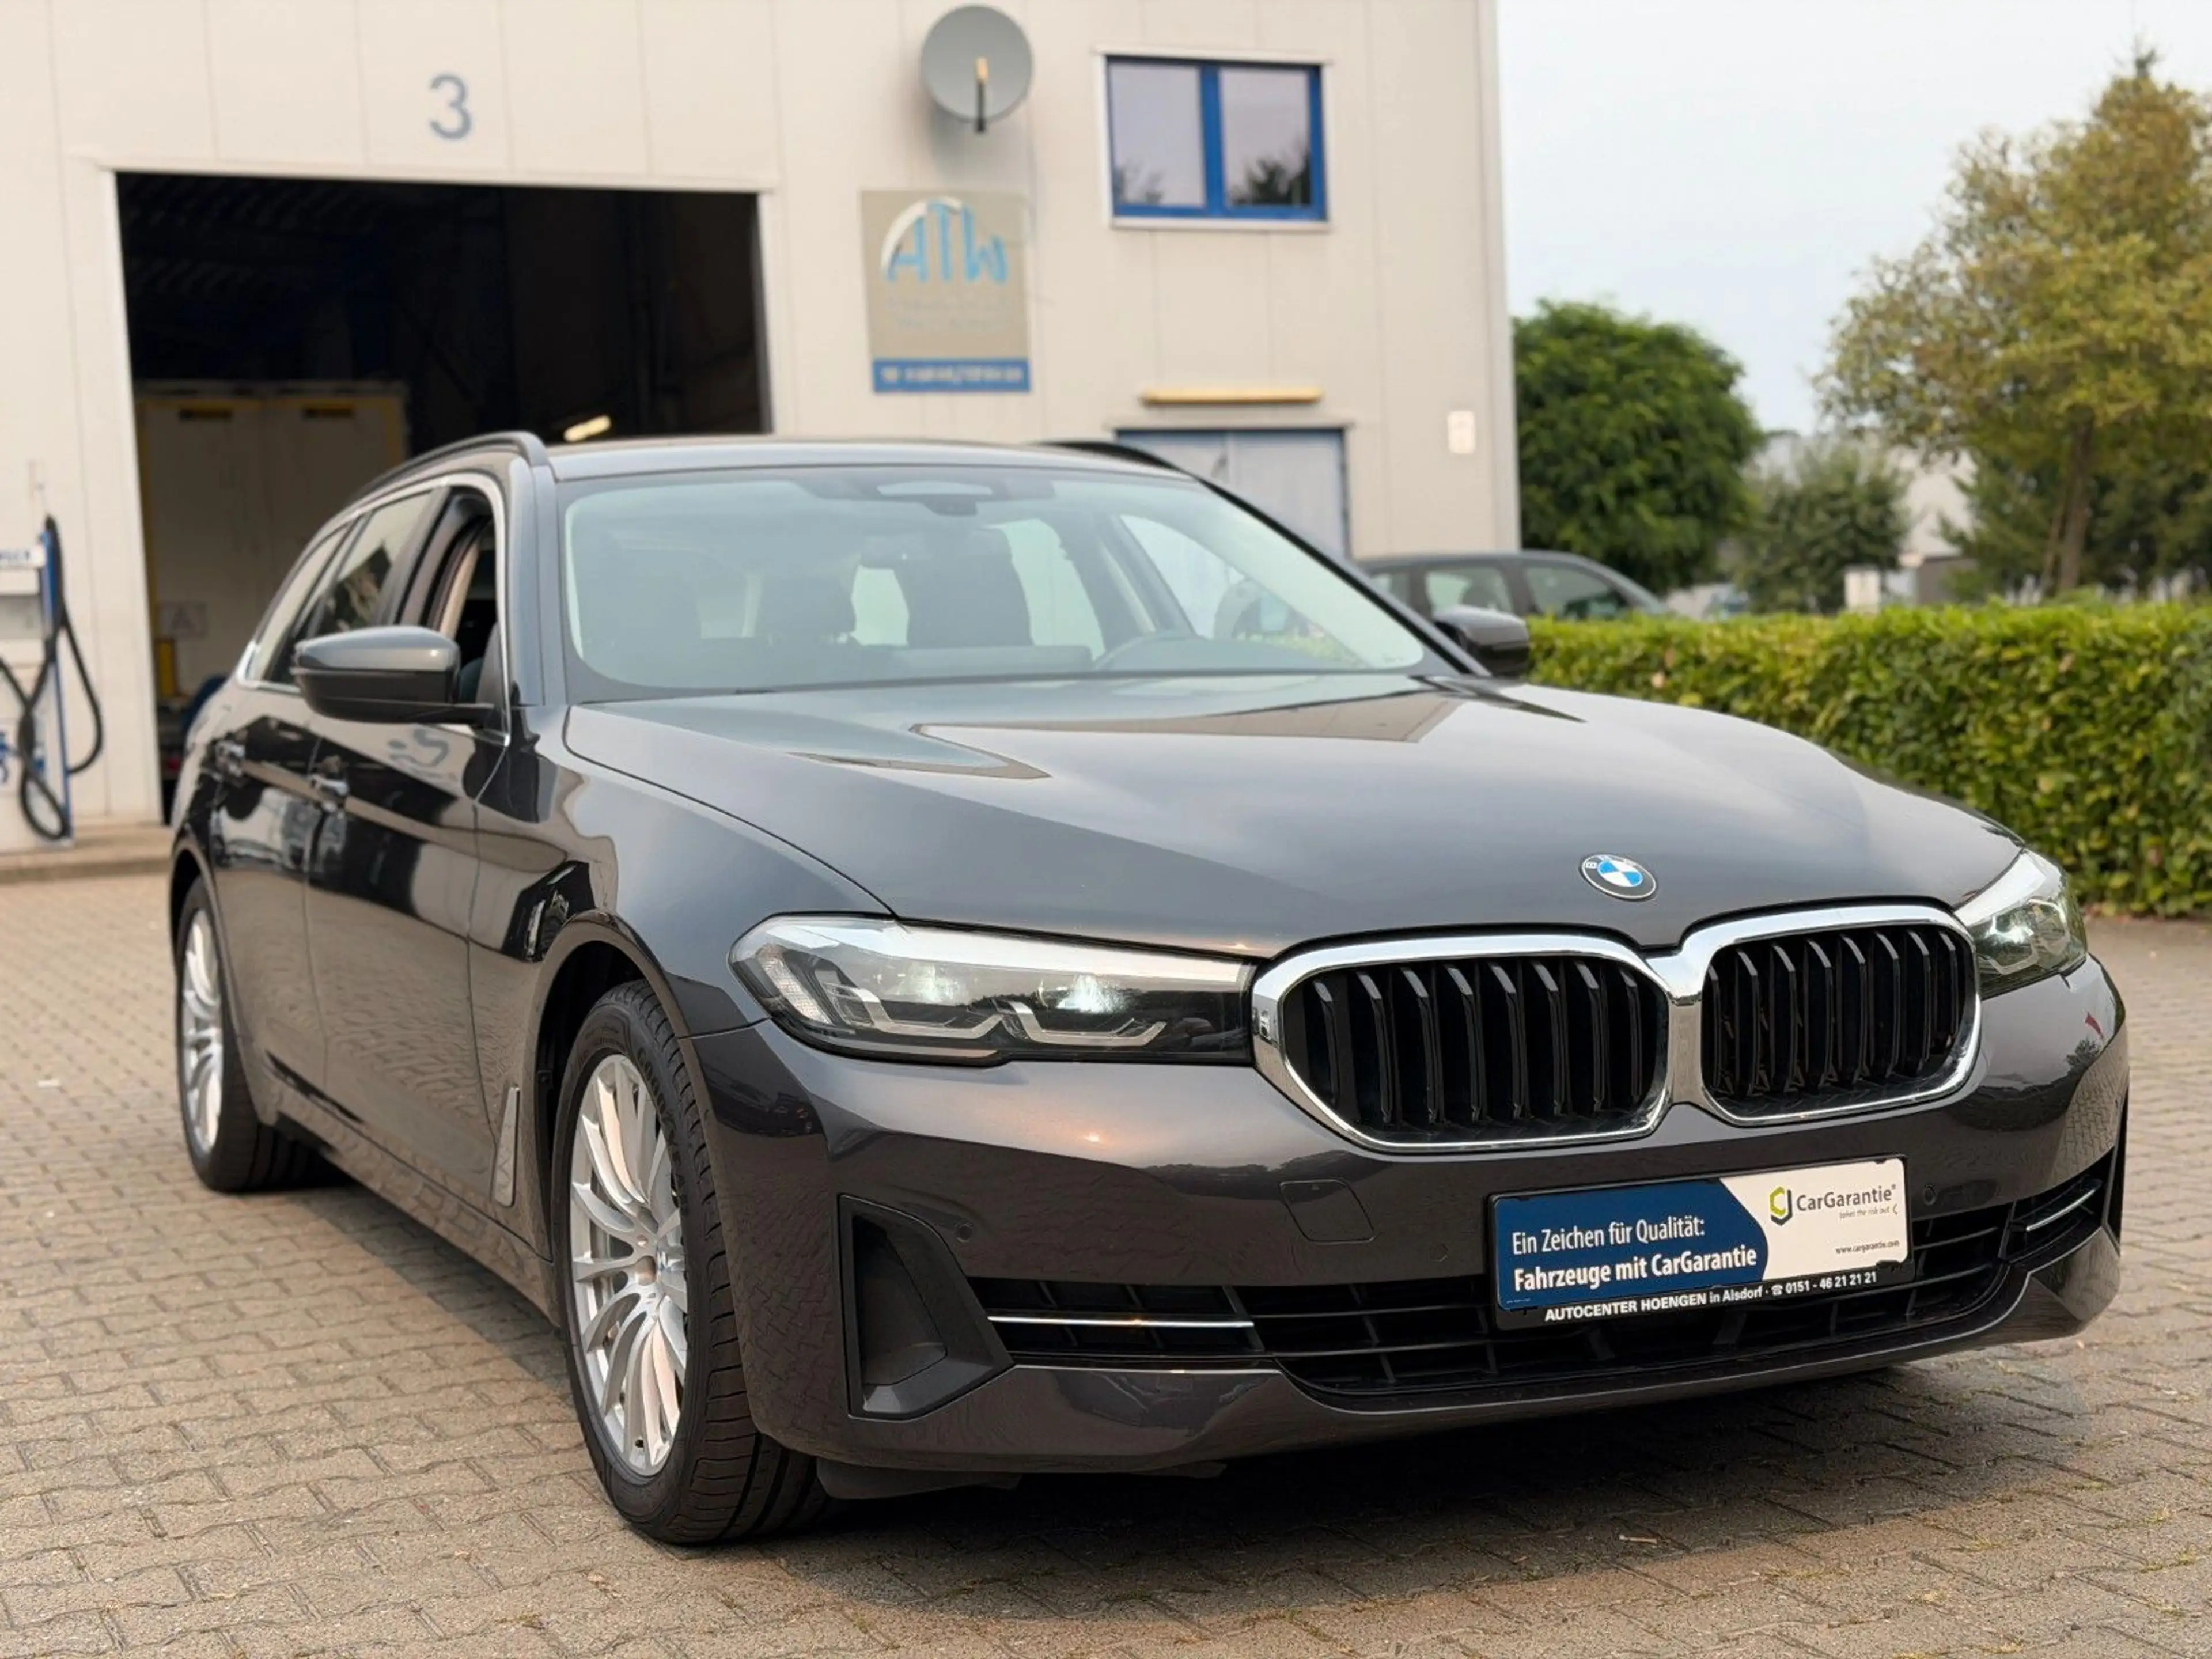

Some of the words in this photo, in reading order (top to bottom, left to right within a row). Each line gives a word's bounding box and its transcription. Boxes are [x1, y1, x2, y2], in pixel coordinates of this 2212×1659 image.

[430, 74, 471, 140] 3
[1512, 1232, 1537, 1255] Ein
[1541, 1225, 1604, 1252] Zeichen
[1608, 1221, 1633, 1245] für
[1636, 1215, 1705, 1244] Qualität:
[1514, 1264, 1611, 1291] Fahrzeuge
[1615, 1256, 1648, 1281] mit
[1651, 1244, 1757, 1277] CarGarantie
[1544, 1301, 1638, 1322] AUTOCENTER
[1641, 1292, 1707, 1312] HOENGEN
[1709, 1291, 1721, 1304] in
[1722, 1286, 1763, 1302] Alsdorf
[1786, 1280, 1810, 1294] 0151
[1819, 1277, 1832, 1290] 46
[1835, 1274, 1846, 1287] 21
[1850, 1273, 1862, 1285] 21
[1864, 1271, 1877, 1283] 21
